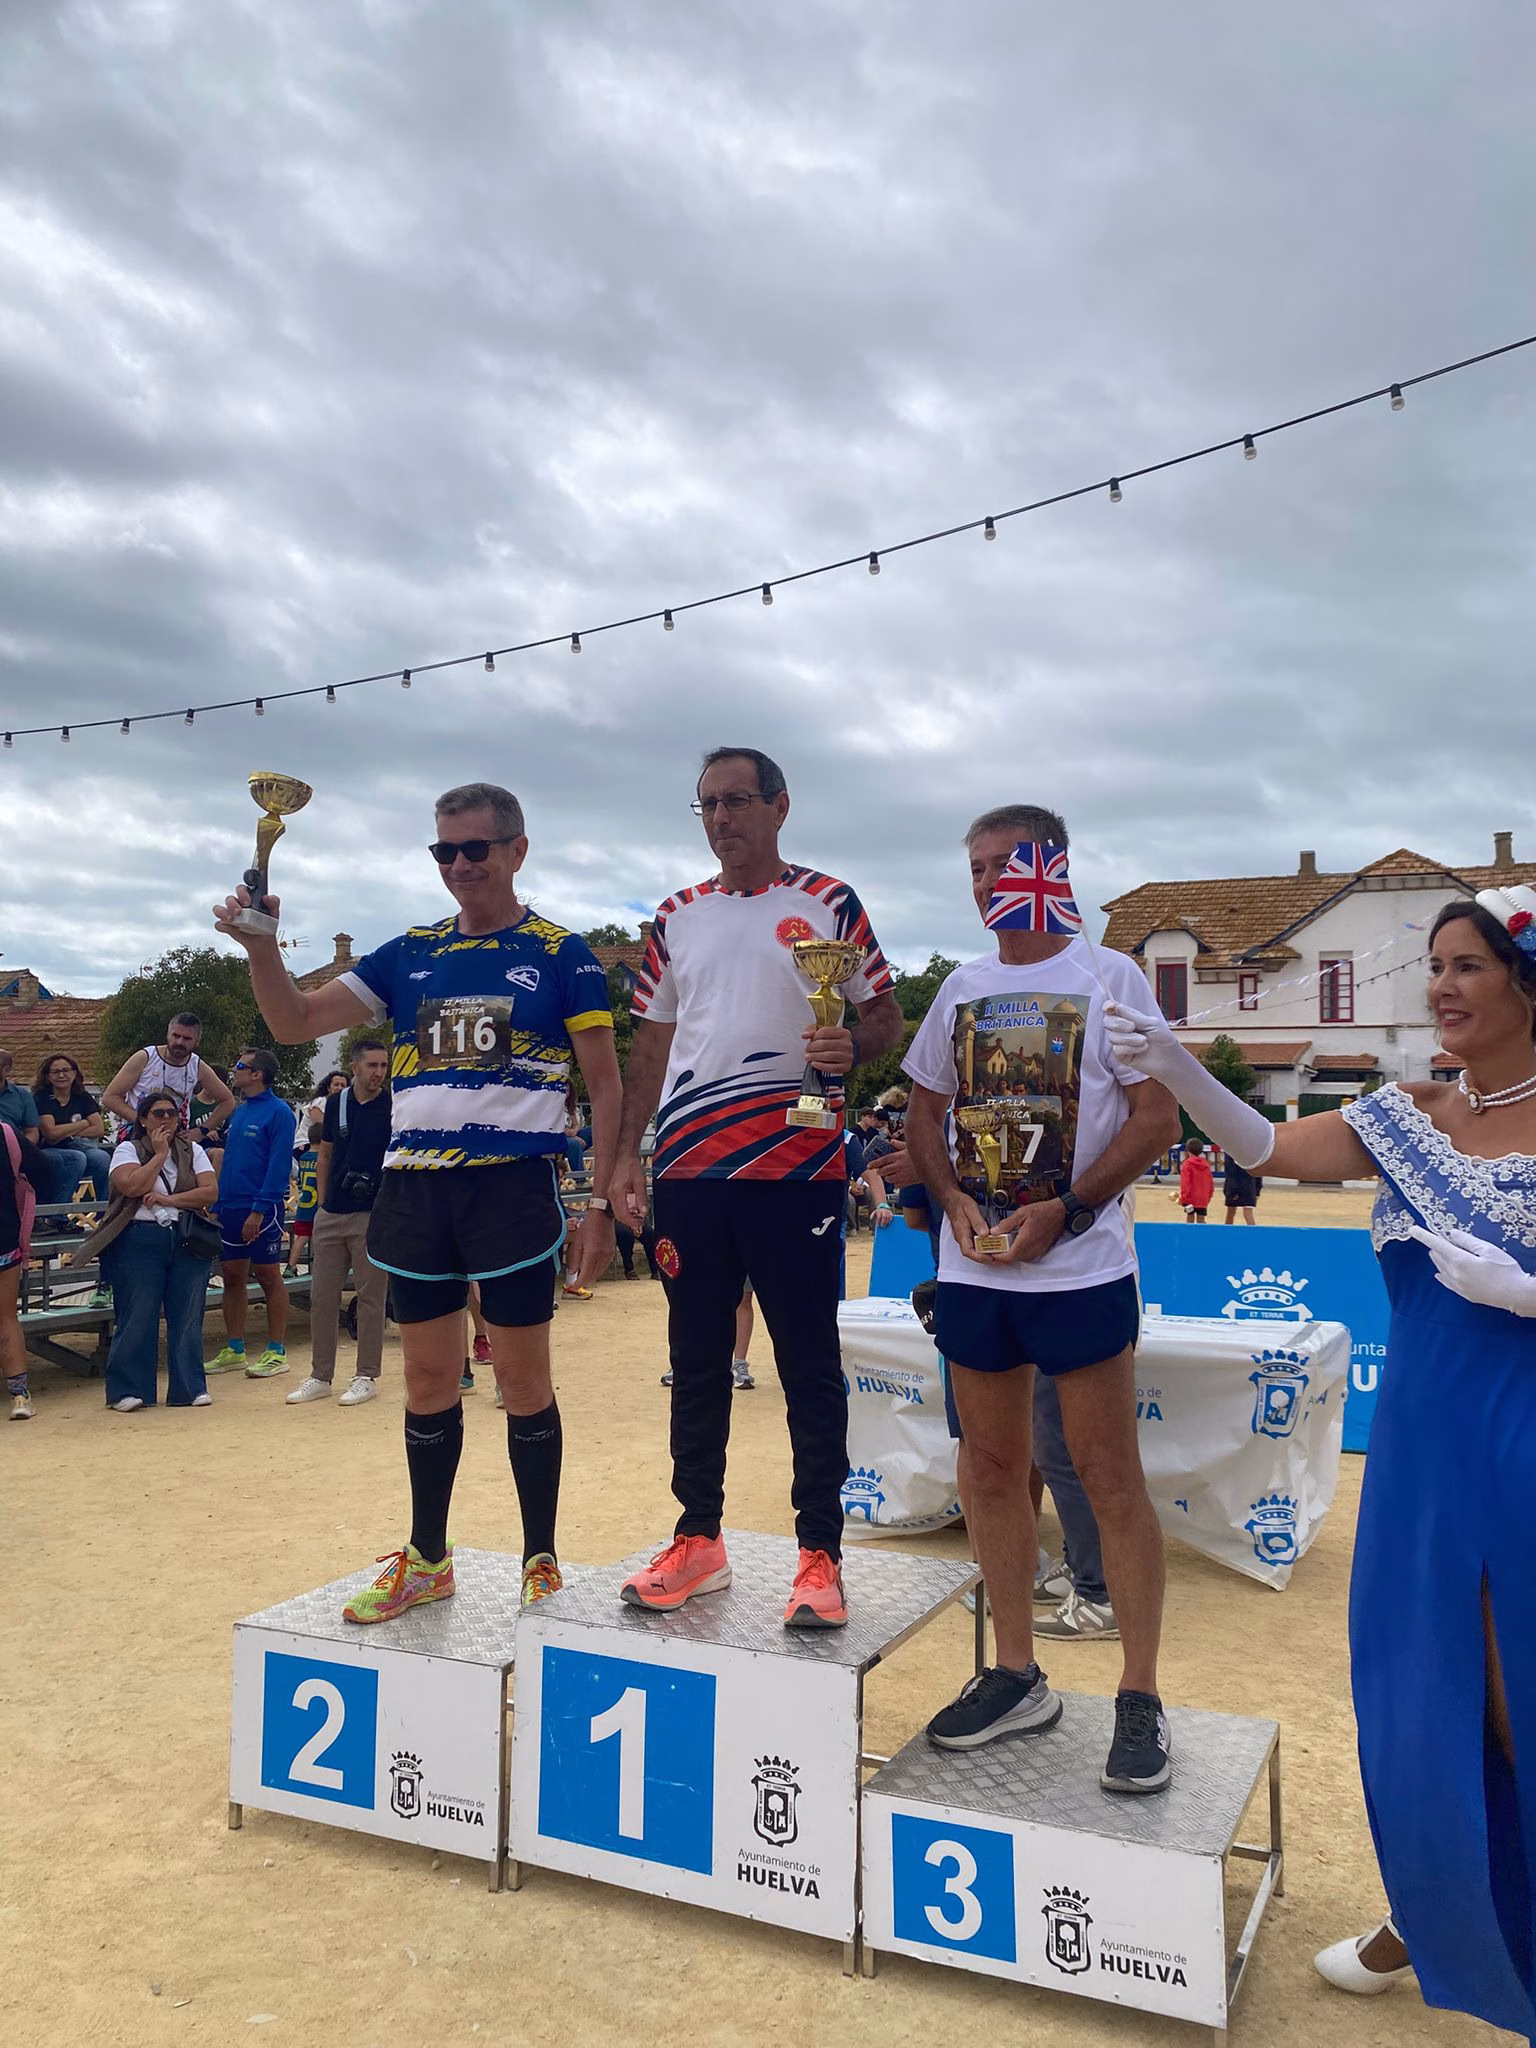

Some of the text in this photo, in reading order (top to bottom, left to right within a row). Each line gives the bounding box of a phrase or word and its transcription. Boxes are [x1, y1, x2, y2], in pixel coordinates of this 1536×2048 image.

[454, 997, 483, 1005] MILLA
[984, 1001, 1039, 1016] II MILLA
[428, 1016, 497, 1055] 116
[976, 1016, 1045, 1031] BRITÁNICA
[912, 1373, 925, 1384] de
[288, 1678, 345, 1791] 2
[590, 1687, 647, 1841] 1
[427, 1790, 475, 1808] Ayuntamiento
[476, 1800, 486, 1809] de
[426, 1801, 484, 1827] HUELVA
[738, 1848, 822, 1876] Ayuntamiento de
[737, 1862, 821, 1900] HUELVA
[923, 1839, 983, 1941] 3
[1100, 1938, 1172, 1961] Ayuntamiento
[1174, 1953, 1188, 1965] de
[1100, 1952, 1188, 1988] HUELVA
